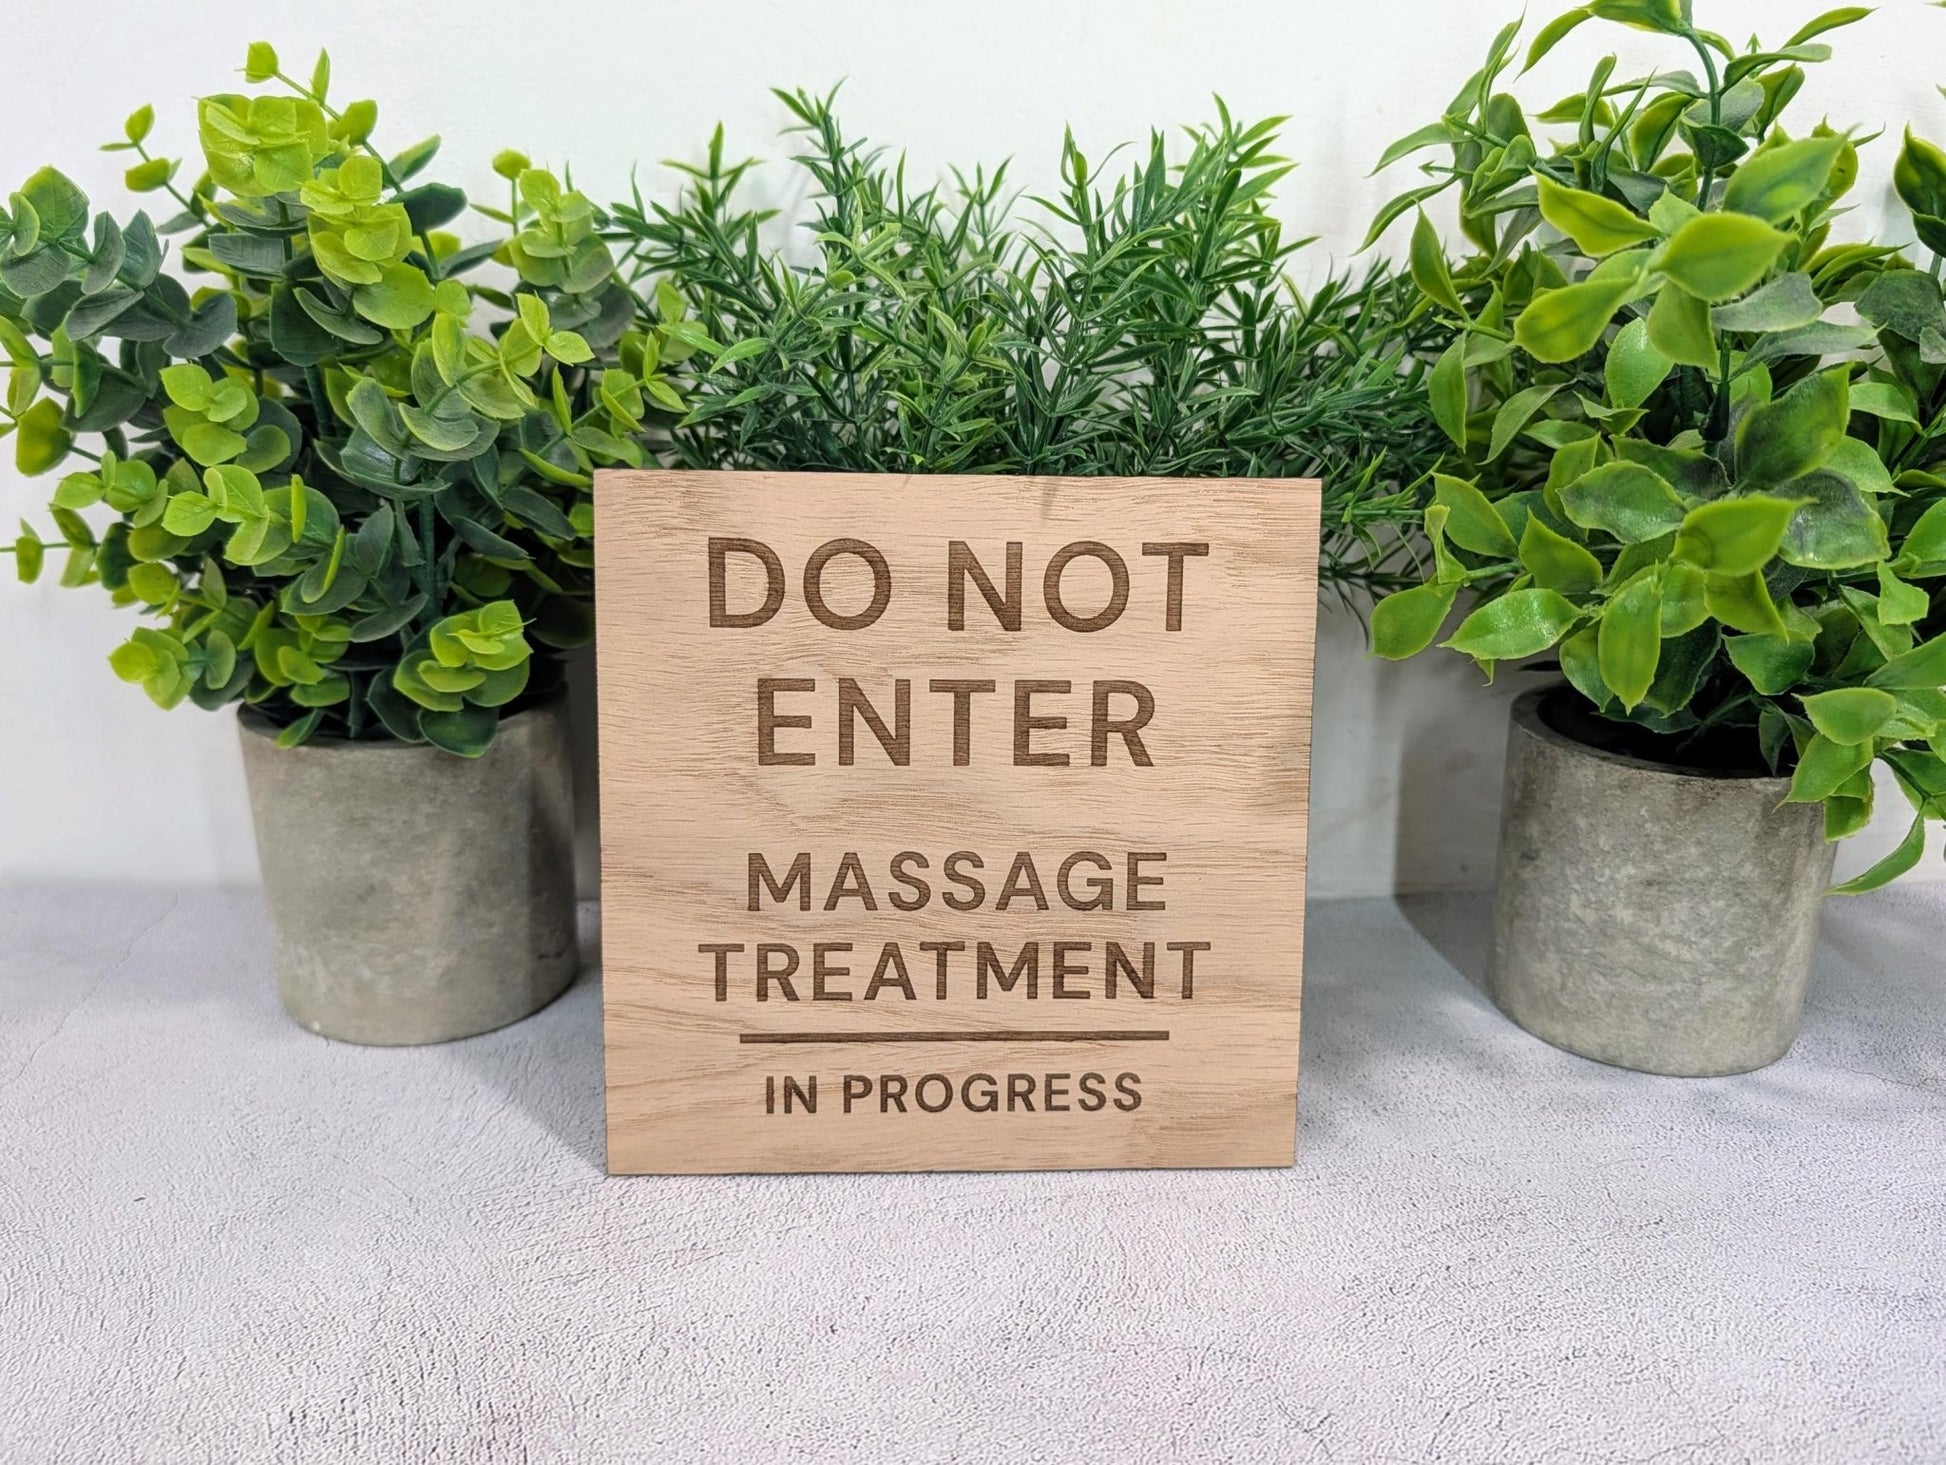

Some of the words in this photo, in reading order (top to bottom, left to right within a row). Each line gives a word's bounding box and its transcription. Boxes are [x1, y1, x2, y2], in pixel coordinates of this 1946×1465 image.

[708, 536, 893, 631] DO
[947, 541, 1210, 634] NOT
[753, 677, 1156, 768] ENTER
[746, 850, 1168, 912] MASSAGE
[698, 940, 1212, 1003] TREATMENT
[765, 1075, 818, 1115] IN
[841, 1071, 1143, 1115] PROGRESS
